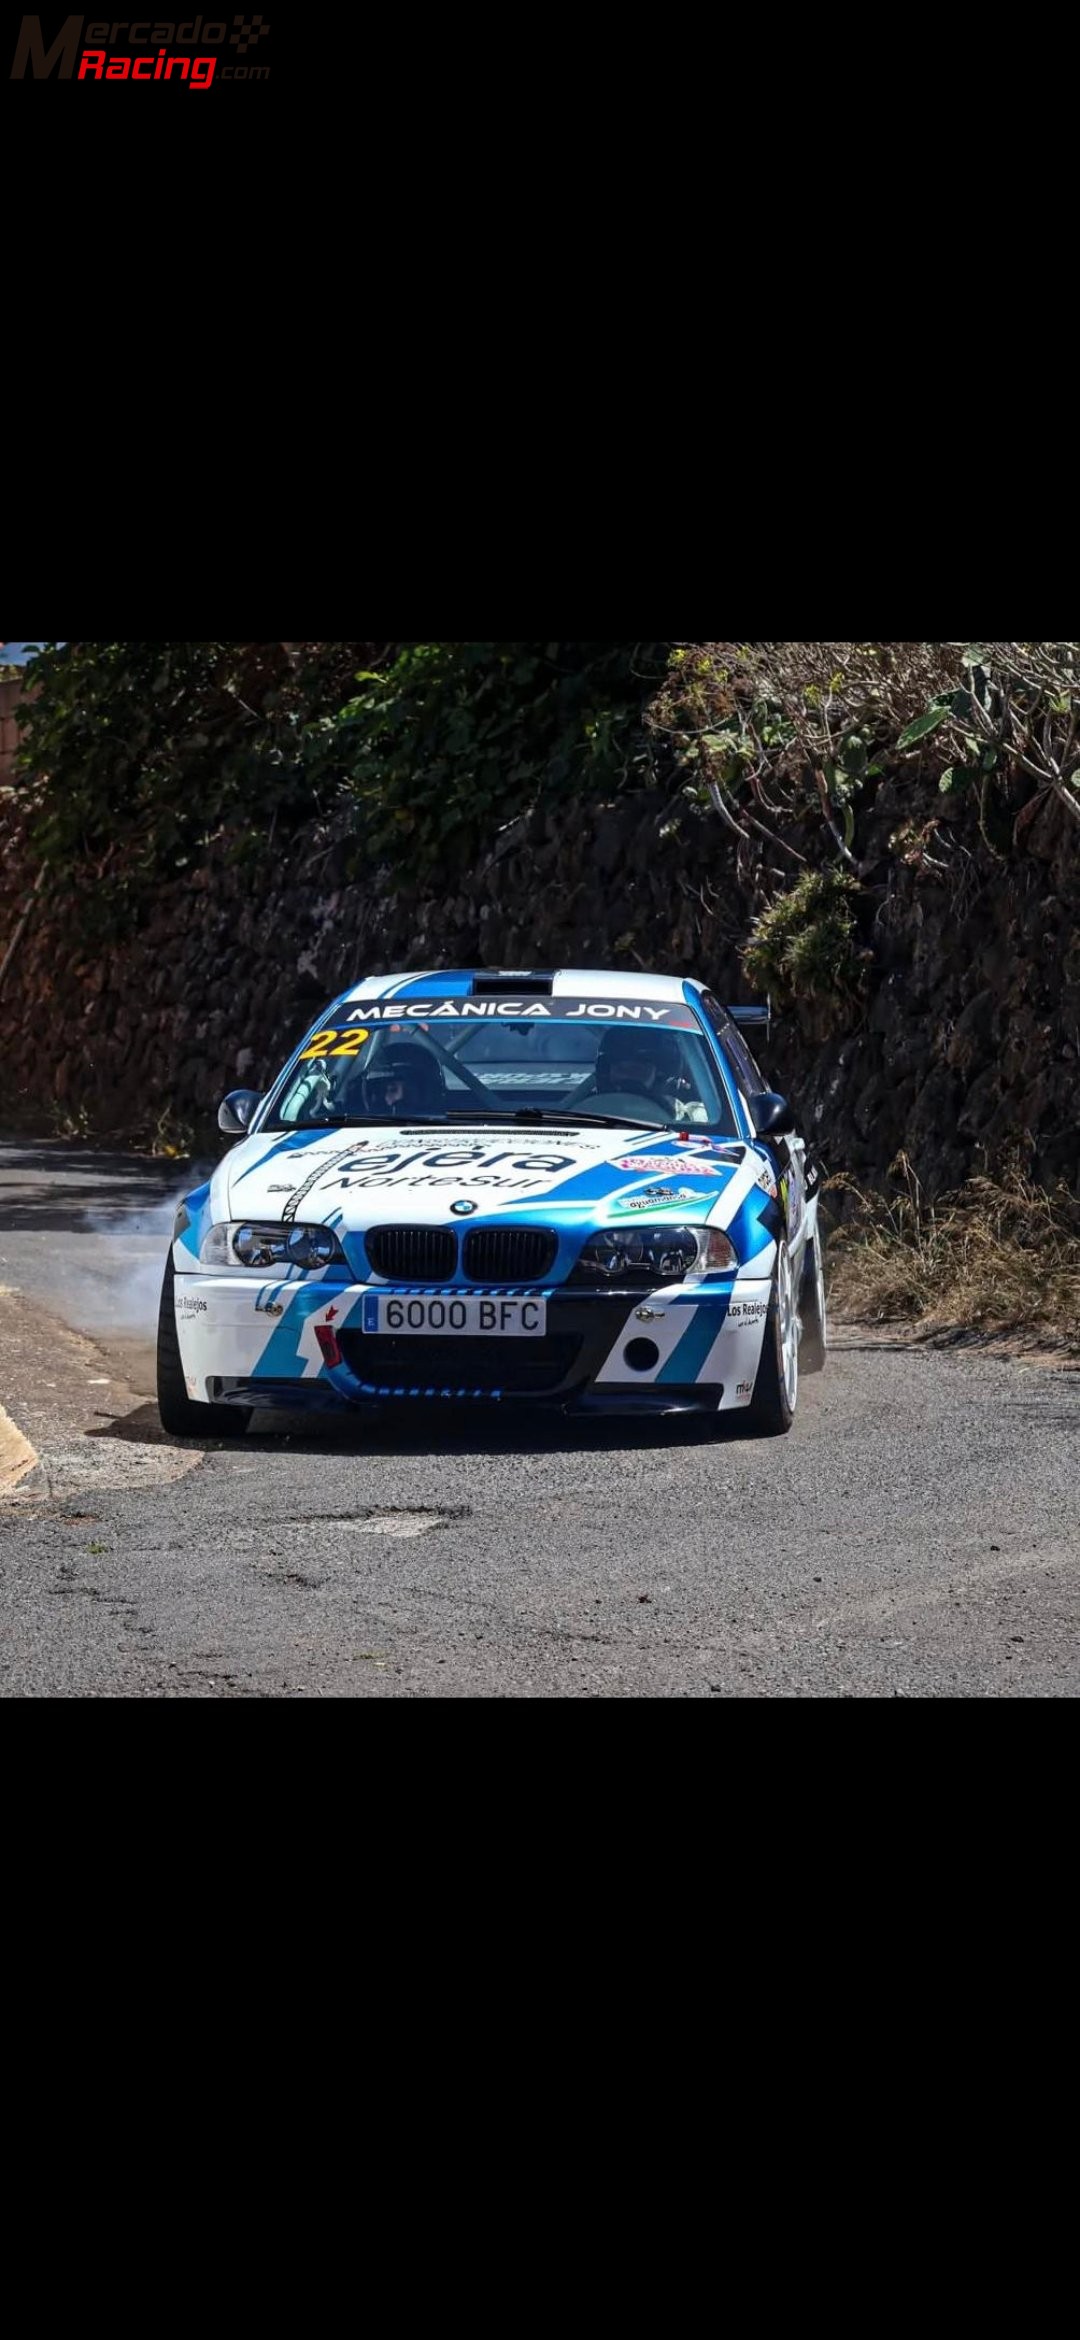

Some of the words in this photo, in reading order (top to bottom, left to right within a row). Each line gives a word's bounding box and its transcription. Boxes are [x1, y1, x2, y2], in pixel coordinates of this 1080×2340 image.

[346, 1000, 551, 1022] MECÁNICA
[566, 1003, 671, 1020] JONY
[299, 1028, 370, 1060] 22
[386, 1299, 467, 1330] 6000
[479, 1301, 539, 1331] BFC
[727, 1304, 741, 1317] Los
